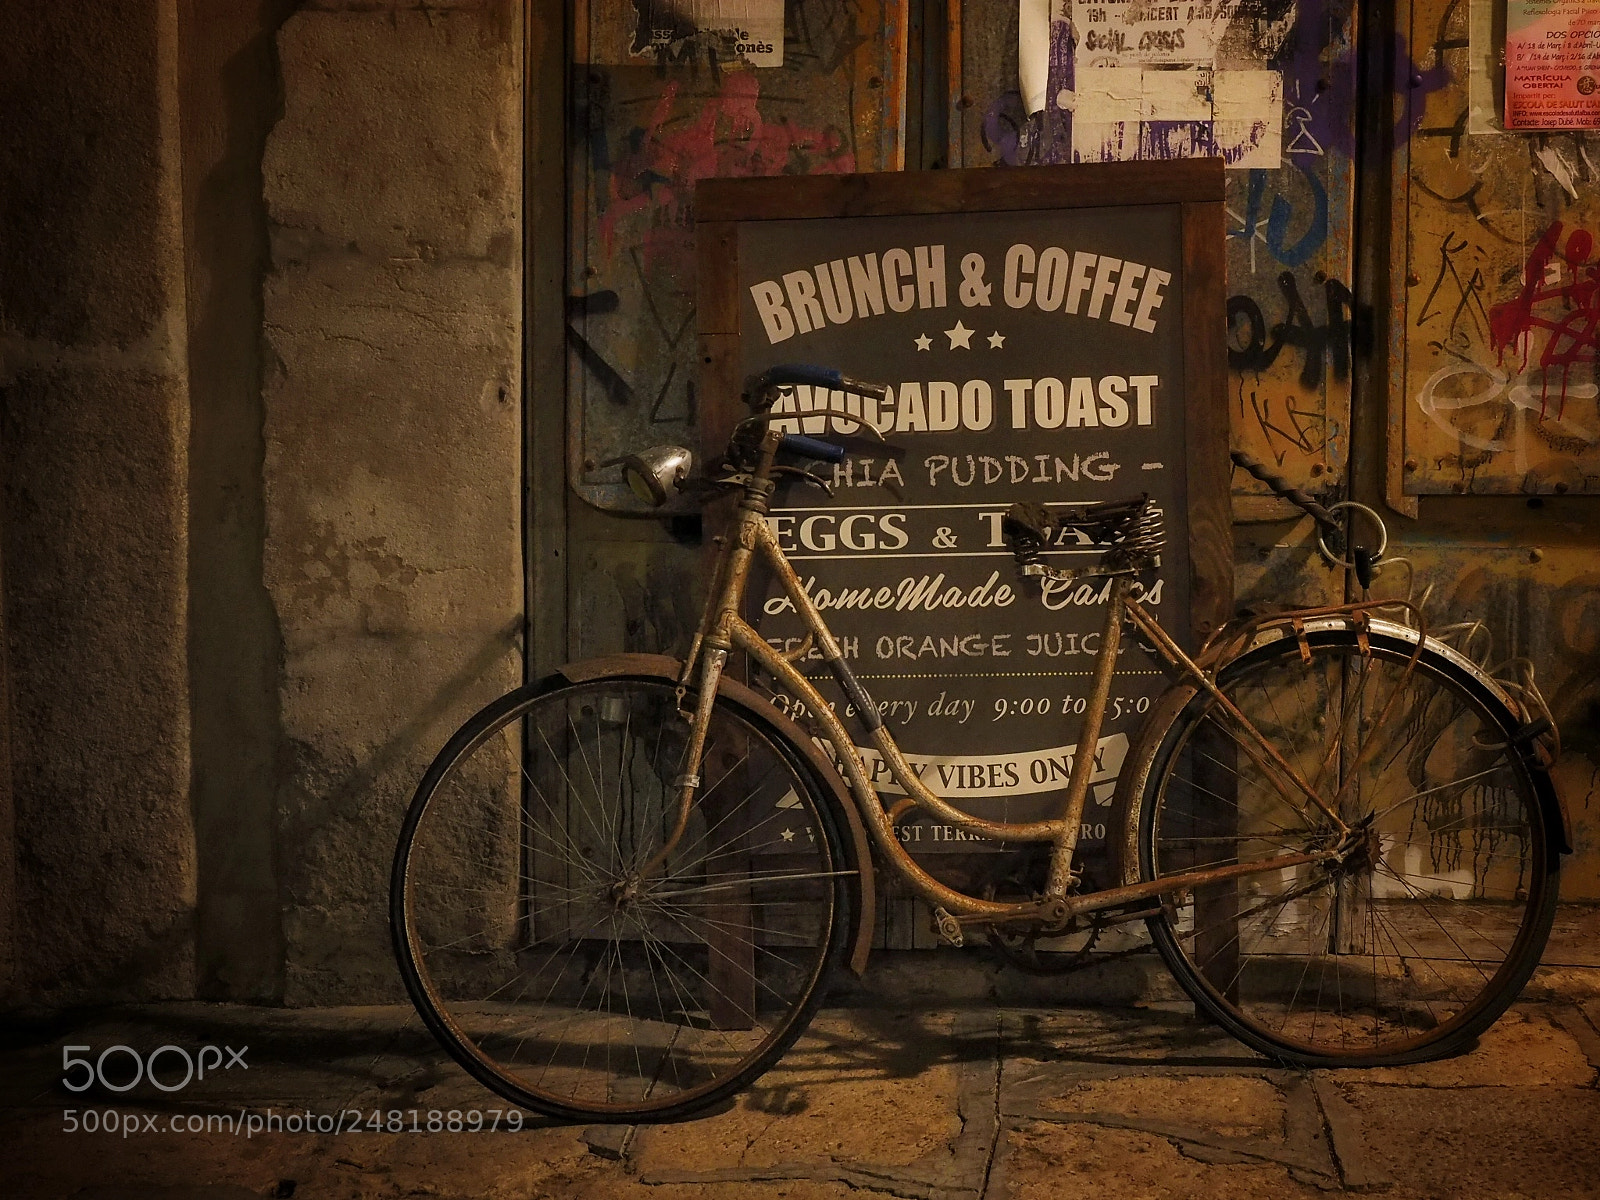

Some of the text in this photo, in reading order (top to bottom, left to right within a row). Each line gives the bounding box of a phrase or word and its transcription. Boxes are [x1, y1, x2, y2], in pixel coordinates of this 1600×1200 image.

[735, 41, 773, 53] onès
[1546, 31, 1567, 39] DOS
[1512, 101, 1544, 109] ESCOLA
[1546, 101, 1557, 109] DE
[1560, 100, 1584, 108] SALUT
[750, 244, 946, 345] BRUNCH
[958, 252, 992, 307] &
[1003, 243, 1172, 334] COFFEE
[768, 375, 1159, 435] AVOCADO TOAST
[924, 452, 1121, 488] PUDDING
[762, 513, 909, 551] EGGS
[931, 526, 959, 549] &
[875, 632, 1013, 660] ORANGE
[926, 692, 975, 720] day
[993, 696, 1051, 723] 9:00
[1062, 694, 1087, 715] to
[936, 762, 1020, 789] VIBES
[1029, 747, 1106, 785] ONY
